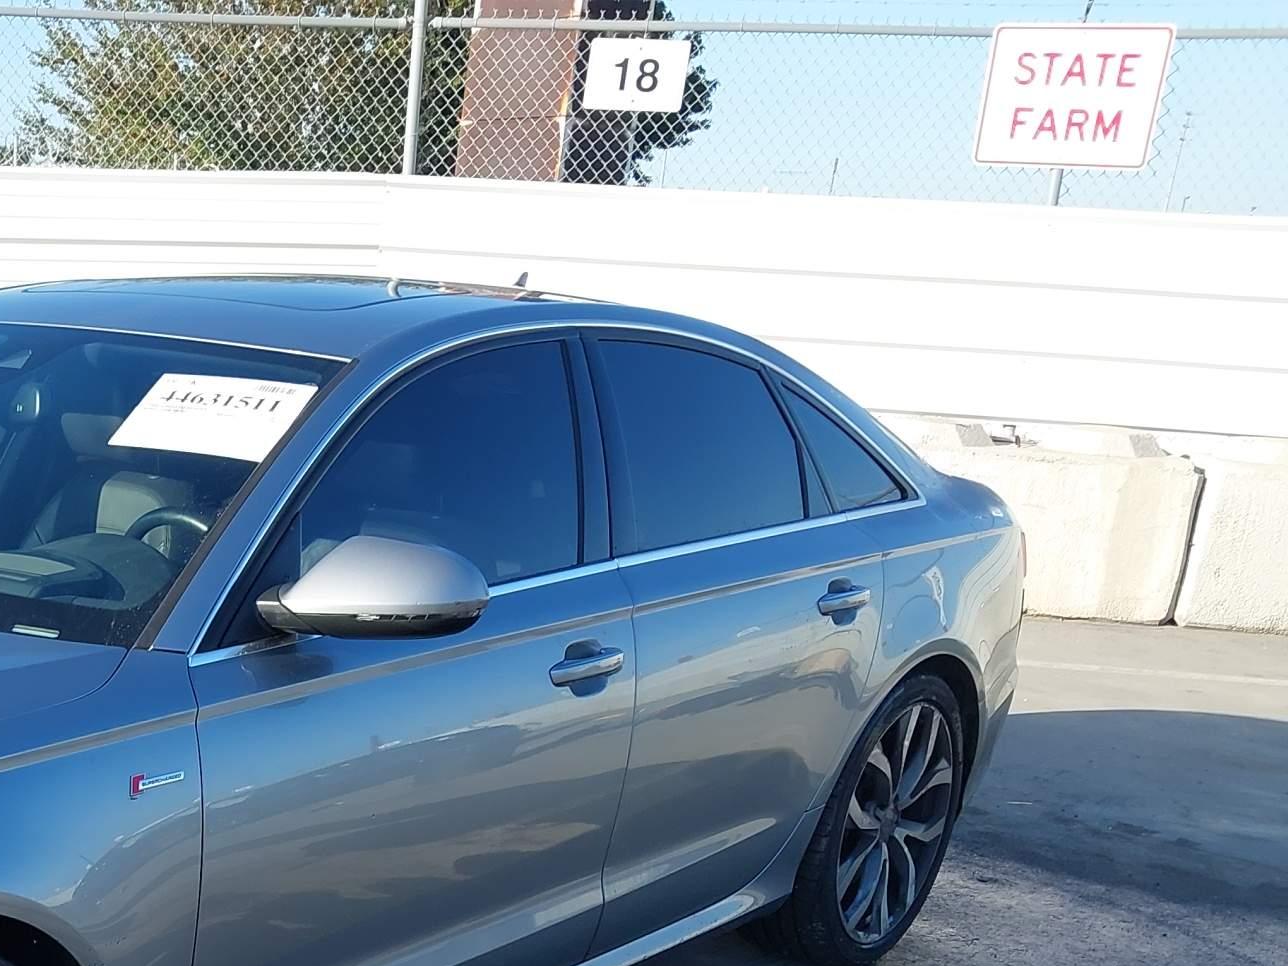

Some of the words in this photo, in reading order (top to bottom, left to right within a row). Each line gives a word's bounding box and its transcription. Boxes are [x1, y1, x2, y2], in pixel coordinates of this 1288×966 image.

[614, 57, 660, 92] 18
[1014, 52, 1142, 87] STATE
[1010, 107, 1123, 142] FARM
[161, 390, 281, 412] 44631511
